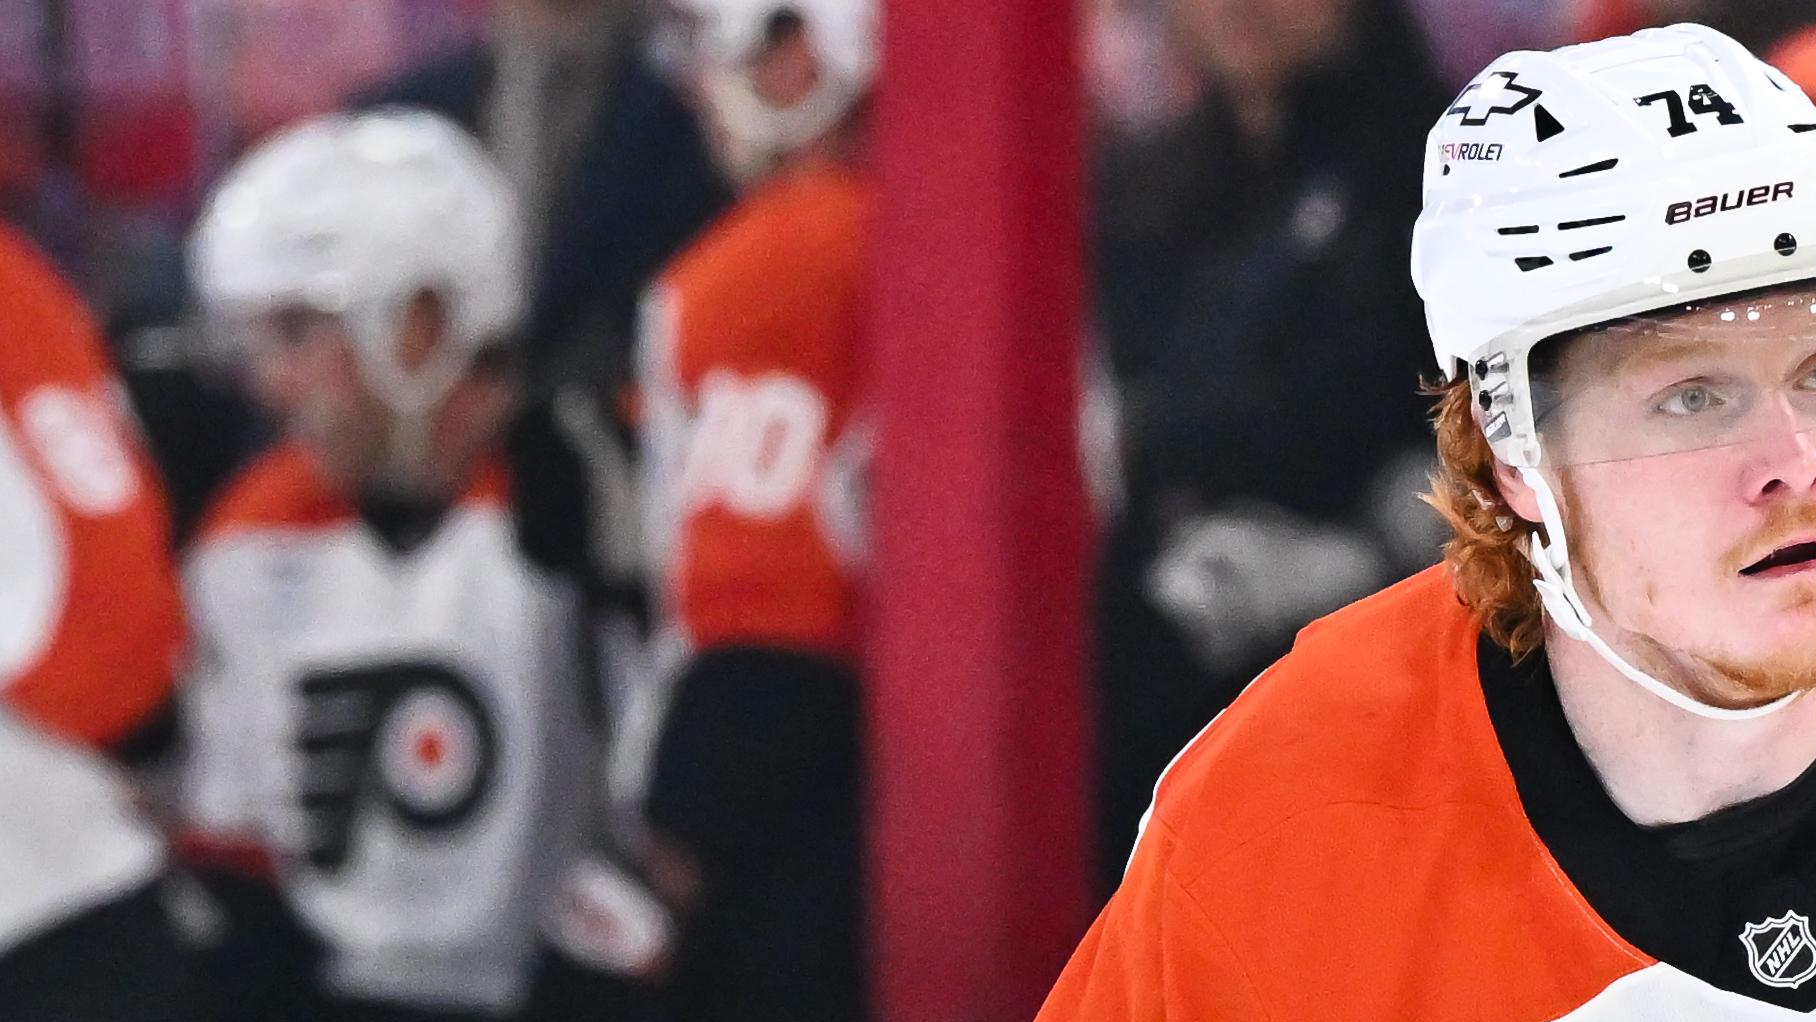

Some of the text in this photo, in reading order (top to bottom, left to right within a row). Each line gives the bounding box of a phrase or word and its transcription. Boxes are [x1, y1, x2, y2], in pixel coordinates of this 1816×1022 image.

[1633, 83, 1744, 138] 74
[1438, 143, 1504, 161] EVROLET
[1665, 180, 1795, 226] BAUER
[1765, 930, 1801, 976] NHL
